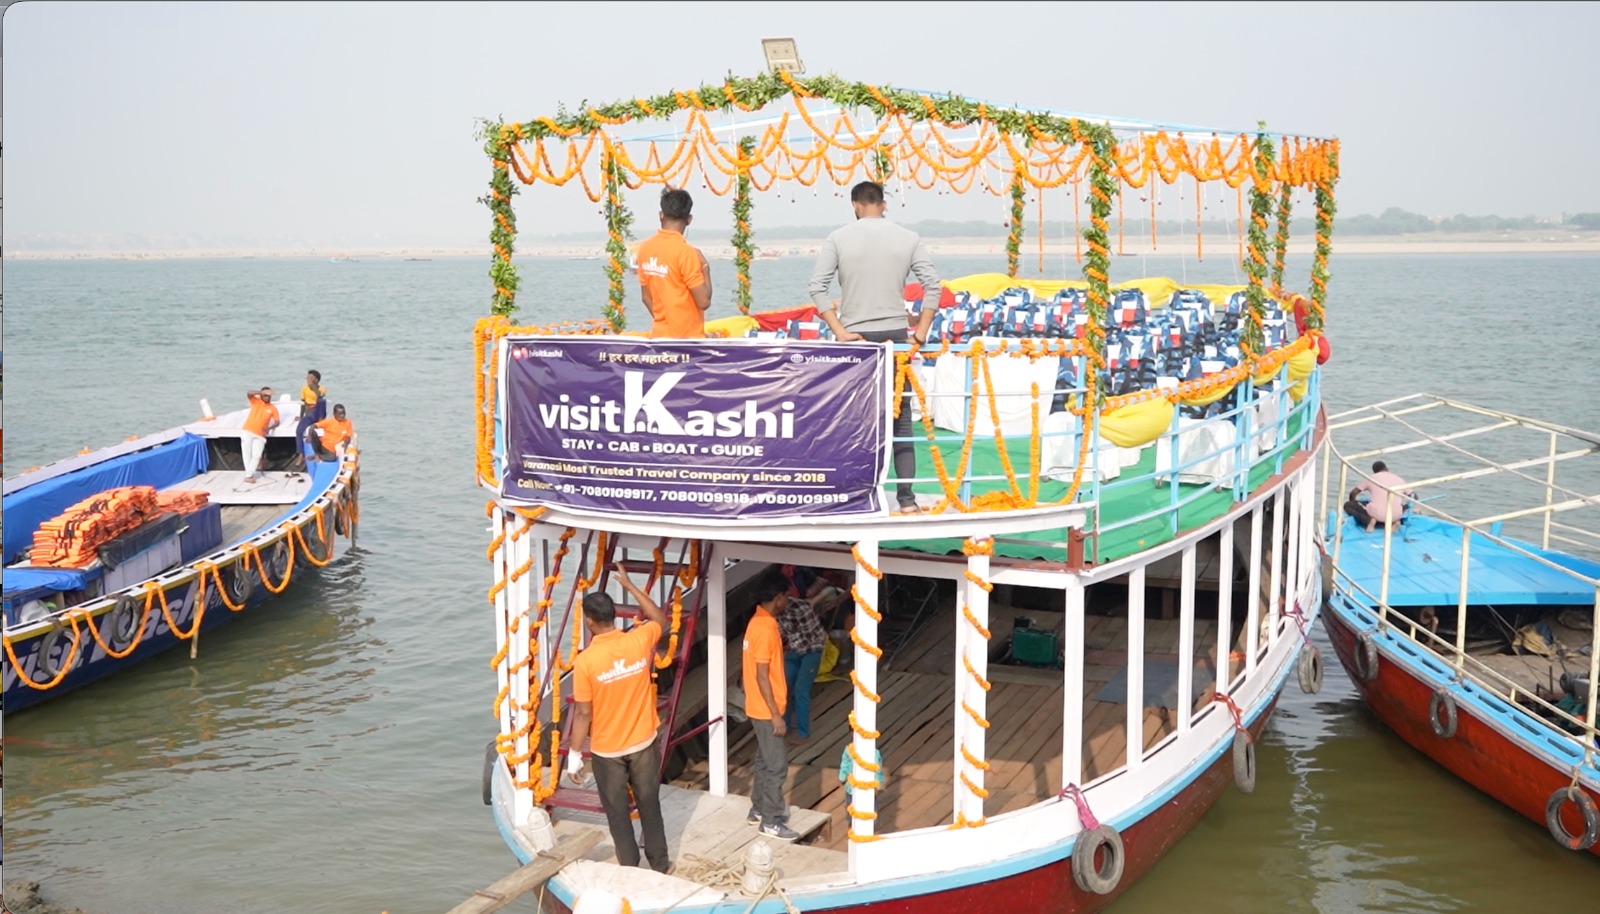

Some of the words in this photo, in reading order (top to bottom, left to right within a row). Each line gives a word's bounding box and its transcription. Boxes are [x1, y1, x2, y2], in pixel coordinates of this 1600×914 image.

[640, 351, 679, 365] महादेव
[561, 438, 595, 450] STAY
[608, 440, 640, 452] CAB
[652, 442, 698, 454] BOAT
[711, 444, 764, 457] GUIDE
[562, 463, 588, 474] Most
[590, 465, 634, 477] Trusted
[636, 467, 677, 478] Travel
[679, 469, 750, 483] Company
[752, 471, 791, 482] since
[793, 472, 826, 483] 2018
[517, 478, 534, 489] Call
